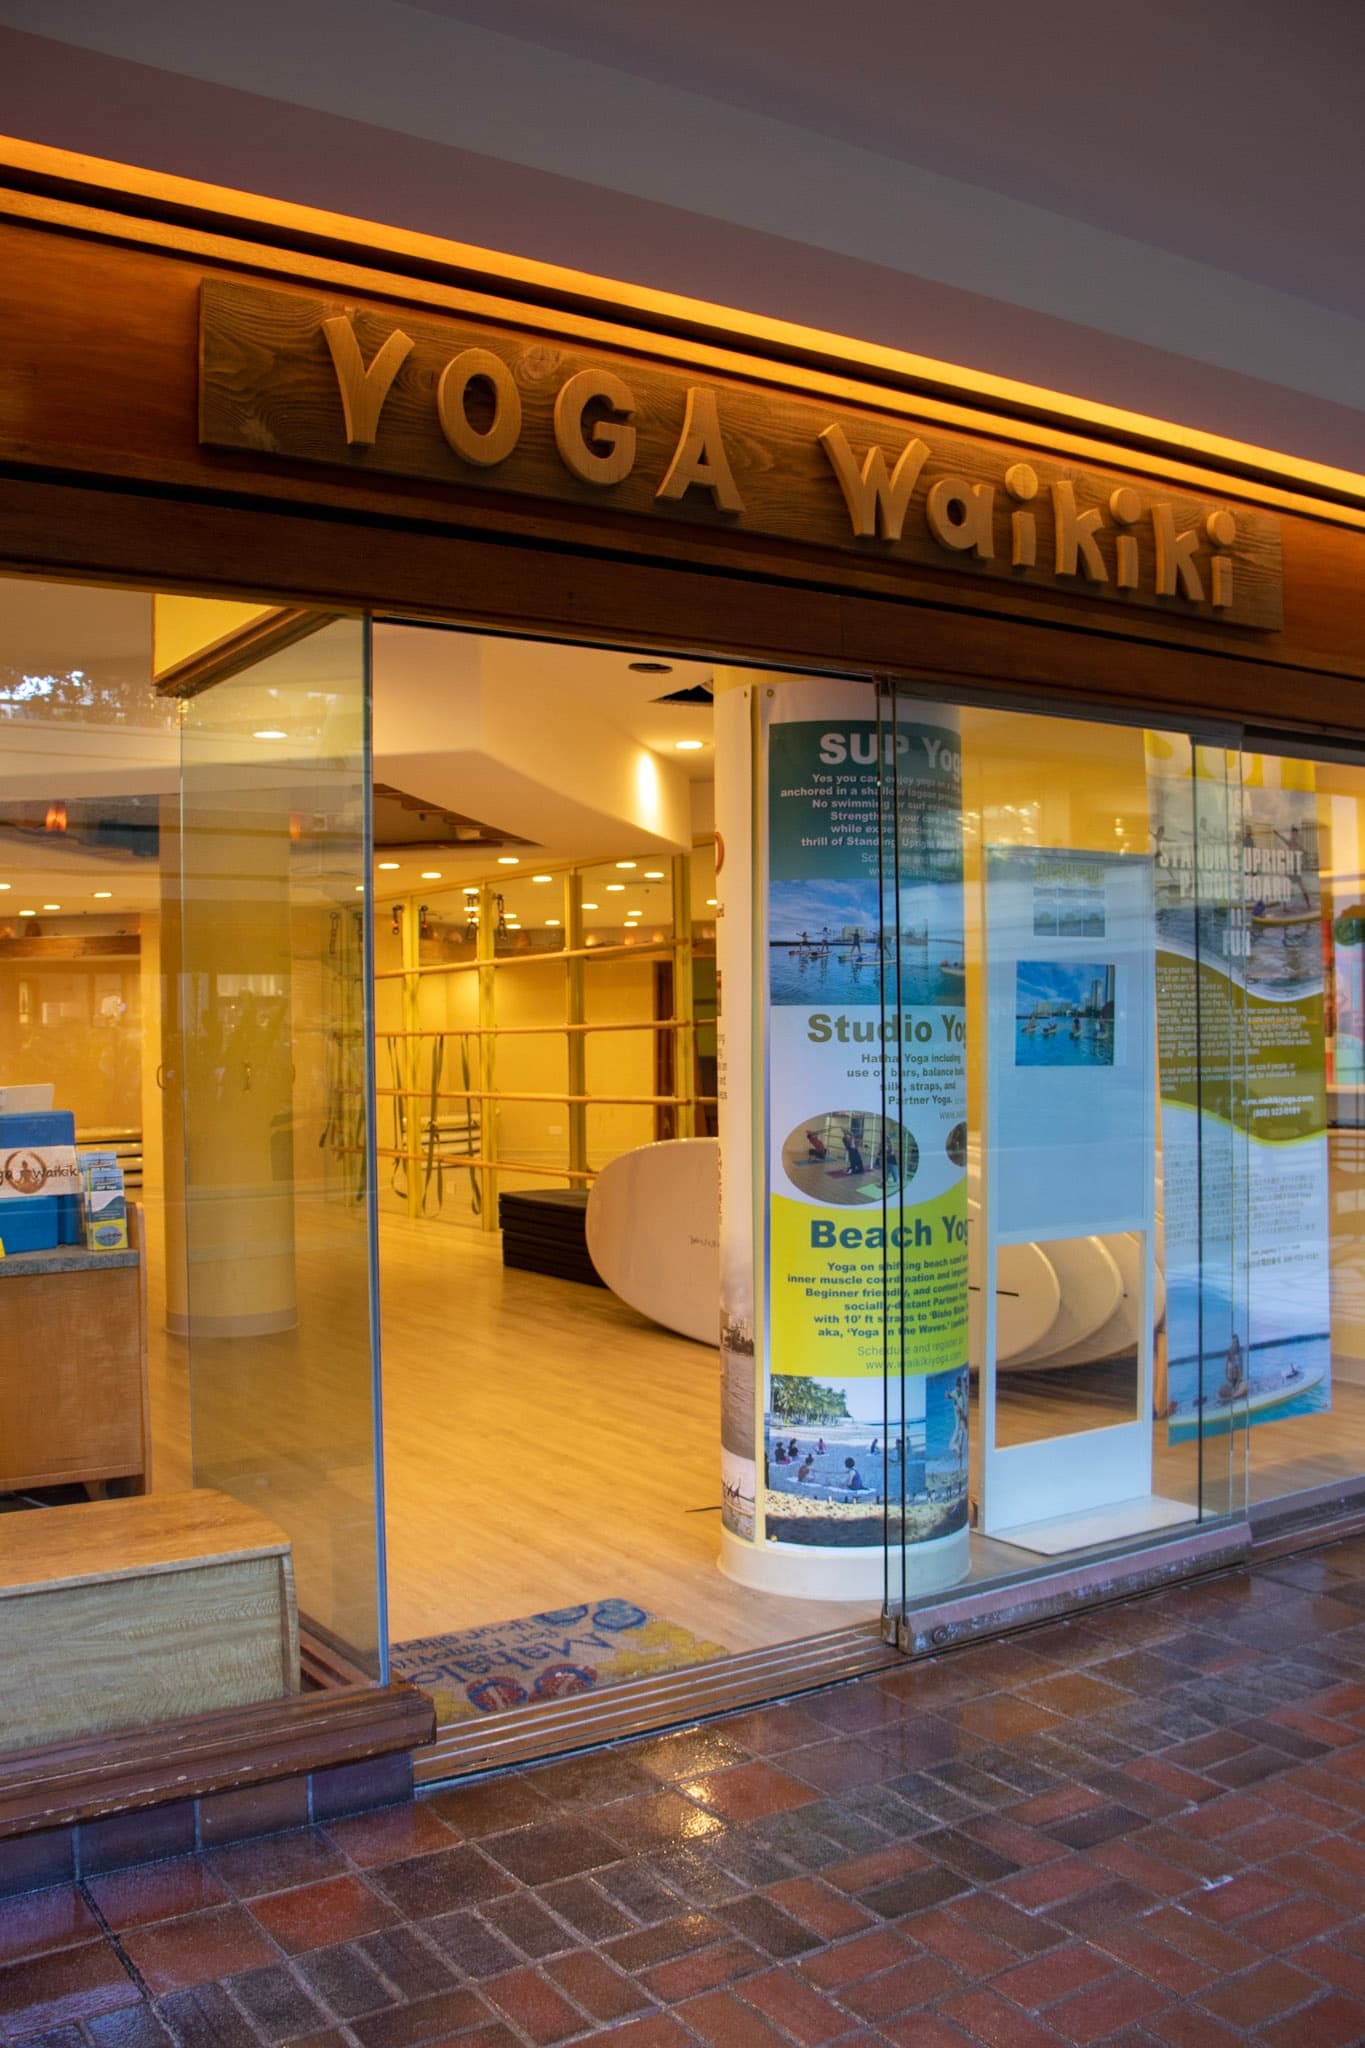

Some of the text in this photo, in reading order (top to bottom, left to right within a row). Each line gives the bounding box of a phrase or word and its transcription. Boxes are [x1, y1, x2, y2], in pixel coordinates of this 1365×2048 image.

[320, 315, 1236, 608] YOGA Waikiki
[819, 733, 909, 766] SUP
[812, 773, 833, 783] Yes
[836, 775, 857, 785] you
[884, 775, 914, 786] ejoy
[780, 786, 833, 797] anchored
[836, 786, 847, 795] in
[850, 788, 858, 796] a
[812, 799, 828, 809] No
[831, 799, 890, 810] swimmig
[831, 823, 862, 833] while
[801, 836, 828, 847] thrill
[831, 836, 843, 846] of
[847, 836, 896, 849] Standng
[807, 1013, 932, 1044] Studio
[861, 1053, 899, 1063] Haha
[905, 1053, 928, 1065] Yoga
[847, 1070, 869, 1078] use
[910, 1082, 942, 1093] straps,
[810, 1218, 932, 1249] Beach
[828, 1262, 857, 1273] Yoga
[860, 1263, 875, 1272] on
[878, 1262, 921, 1273] shifing
[787, 1273, 816, 1284] inner
[819, 1275, 863, 1285] muscle
[866, 1273, 935, 1285] coordnation
[805, 1287, 859, 1299] Beginner
[913, 1285, 931, 1296] and
[844, 1299, 931, 1313] socially-dstant
[813, 1314, 840, 1324] with
[864, 1314, 874, 1324] ft
[877, 1314, 914, 1325] sraps
[918, 1312, 927, 1322] to
[818, 1327, 843, 1339] aka,
[857, 1344, 911, 1356] Schedue
[913, 1343, 930, 1353] and
[389, 1638, 507, 1670] removin
